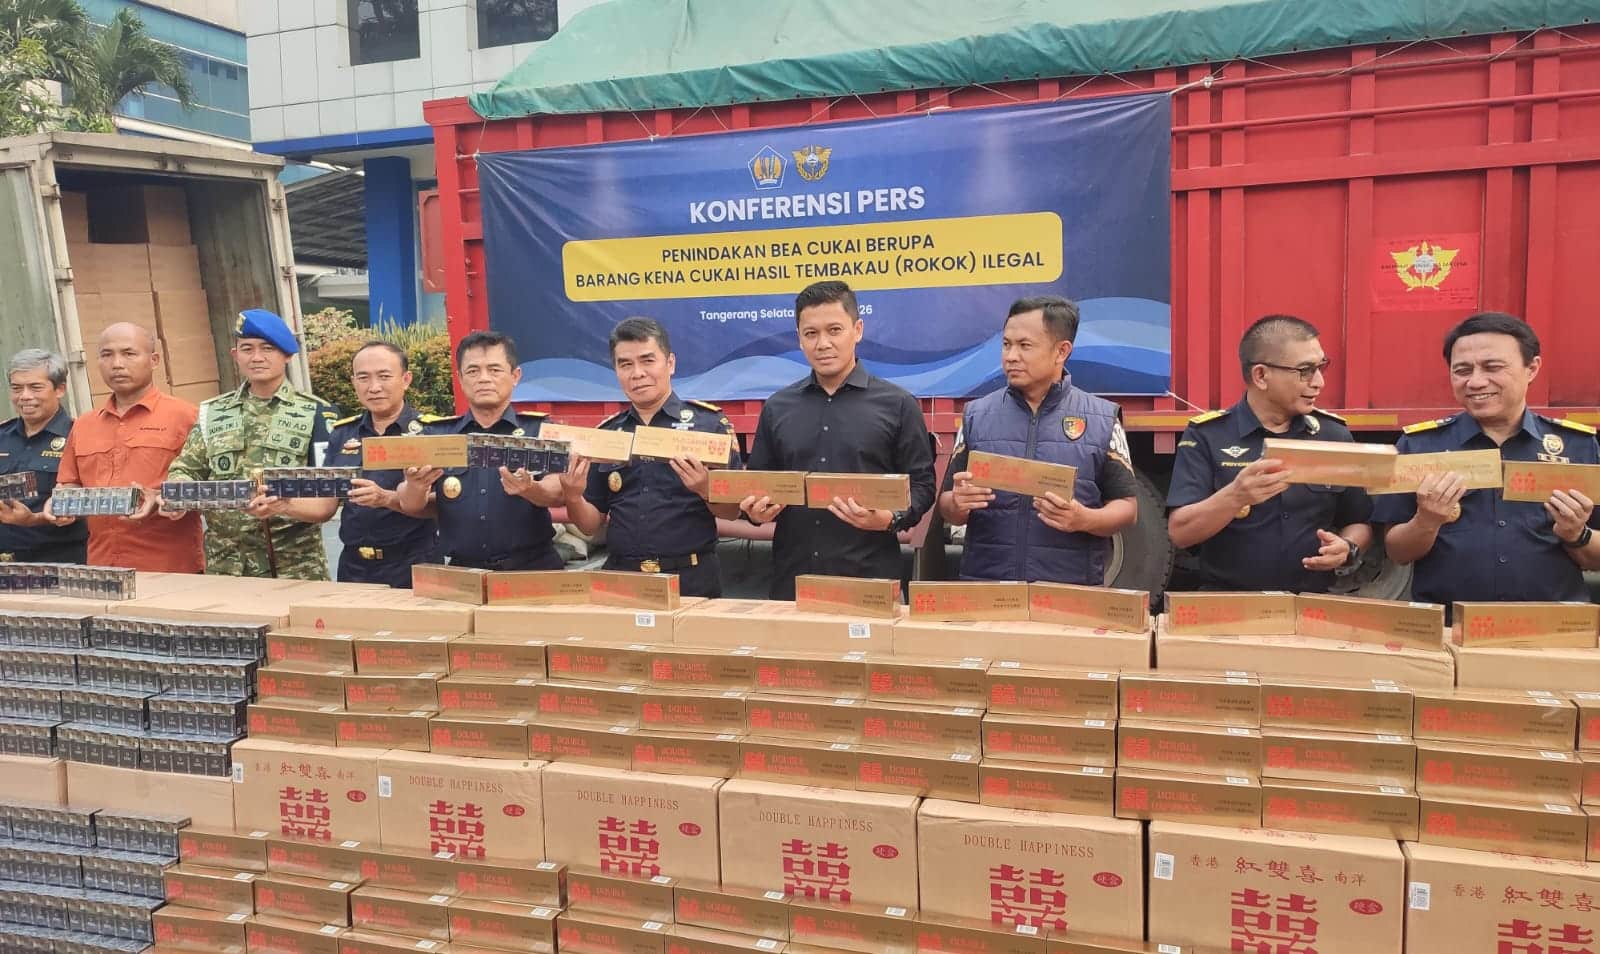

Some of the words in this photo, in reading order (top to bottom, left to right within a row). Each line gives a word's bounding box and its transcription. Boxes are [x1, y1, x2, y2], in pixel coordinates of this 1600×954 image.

[690, 191, 851, 224] KONFERENSI
[857, 186, 926, 213] PERS
[662, 244, 766, 263] PENINDAKAN
[771, 242, 803, 258] BEA
[807, 239, 861, 256] CUKAI
[866, 234, 935, 252] BERUPA
[576, 272, 640, 288] BARANG
[645, 269, 685, 284] KENA
[690, 266, 739, 283] CUKAI
[744, 264, 791, 281] HASIL
[795, 259, 889, 278] TEMBAKAU
[895, 251, 976, 277] (ROKOK)
[983, 252, 1044, 269] ILEGAL
[700, 309, 758, 323] Tangerang
[760, 308, 795, 319] Selata
[858, 305, 873, 315] 26
[409, 775, 444, 788] DOUBLE
[450, 778, 504, 793] HAPPINESS
[577, 790, 615, 804] DOUBLE
[622, 794, 680, 810] HAPPINESS
[759, 811, 801, 825] DOUBLE
[808, 815, 873, 832] HAPPINESS
[964, 834, 1011, 850] DOUBLE
[1020, 840, 1095, 858] HAPPINESS
